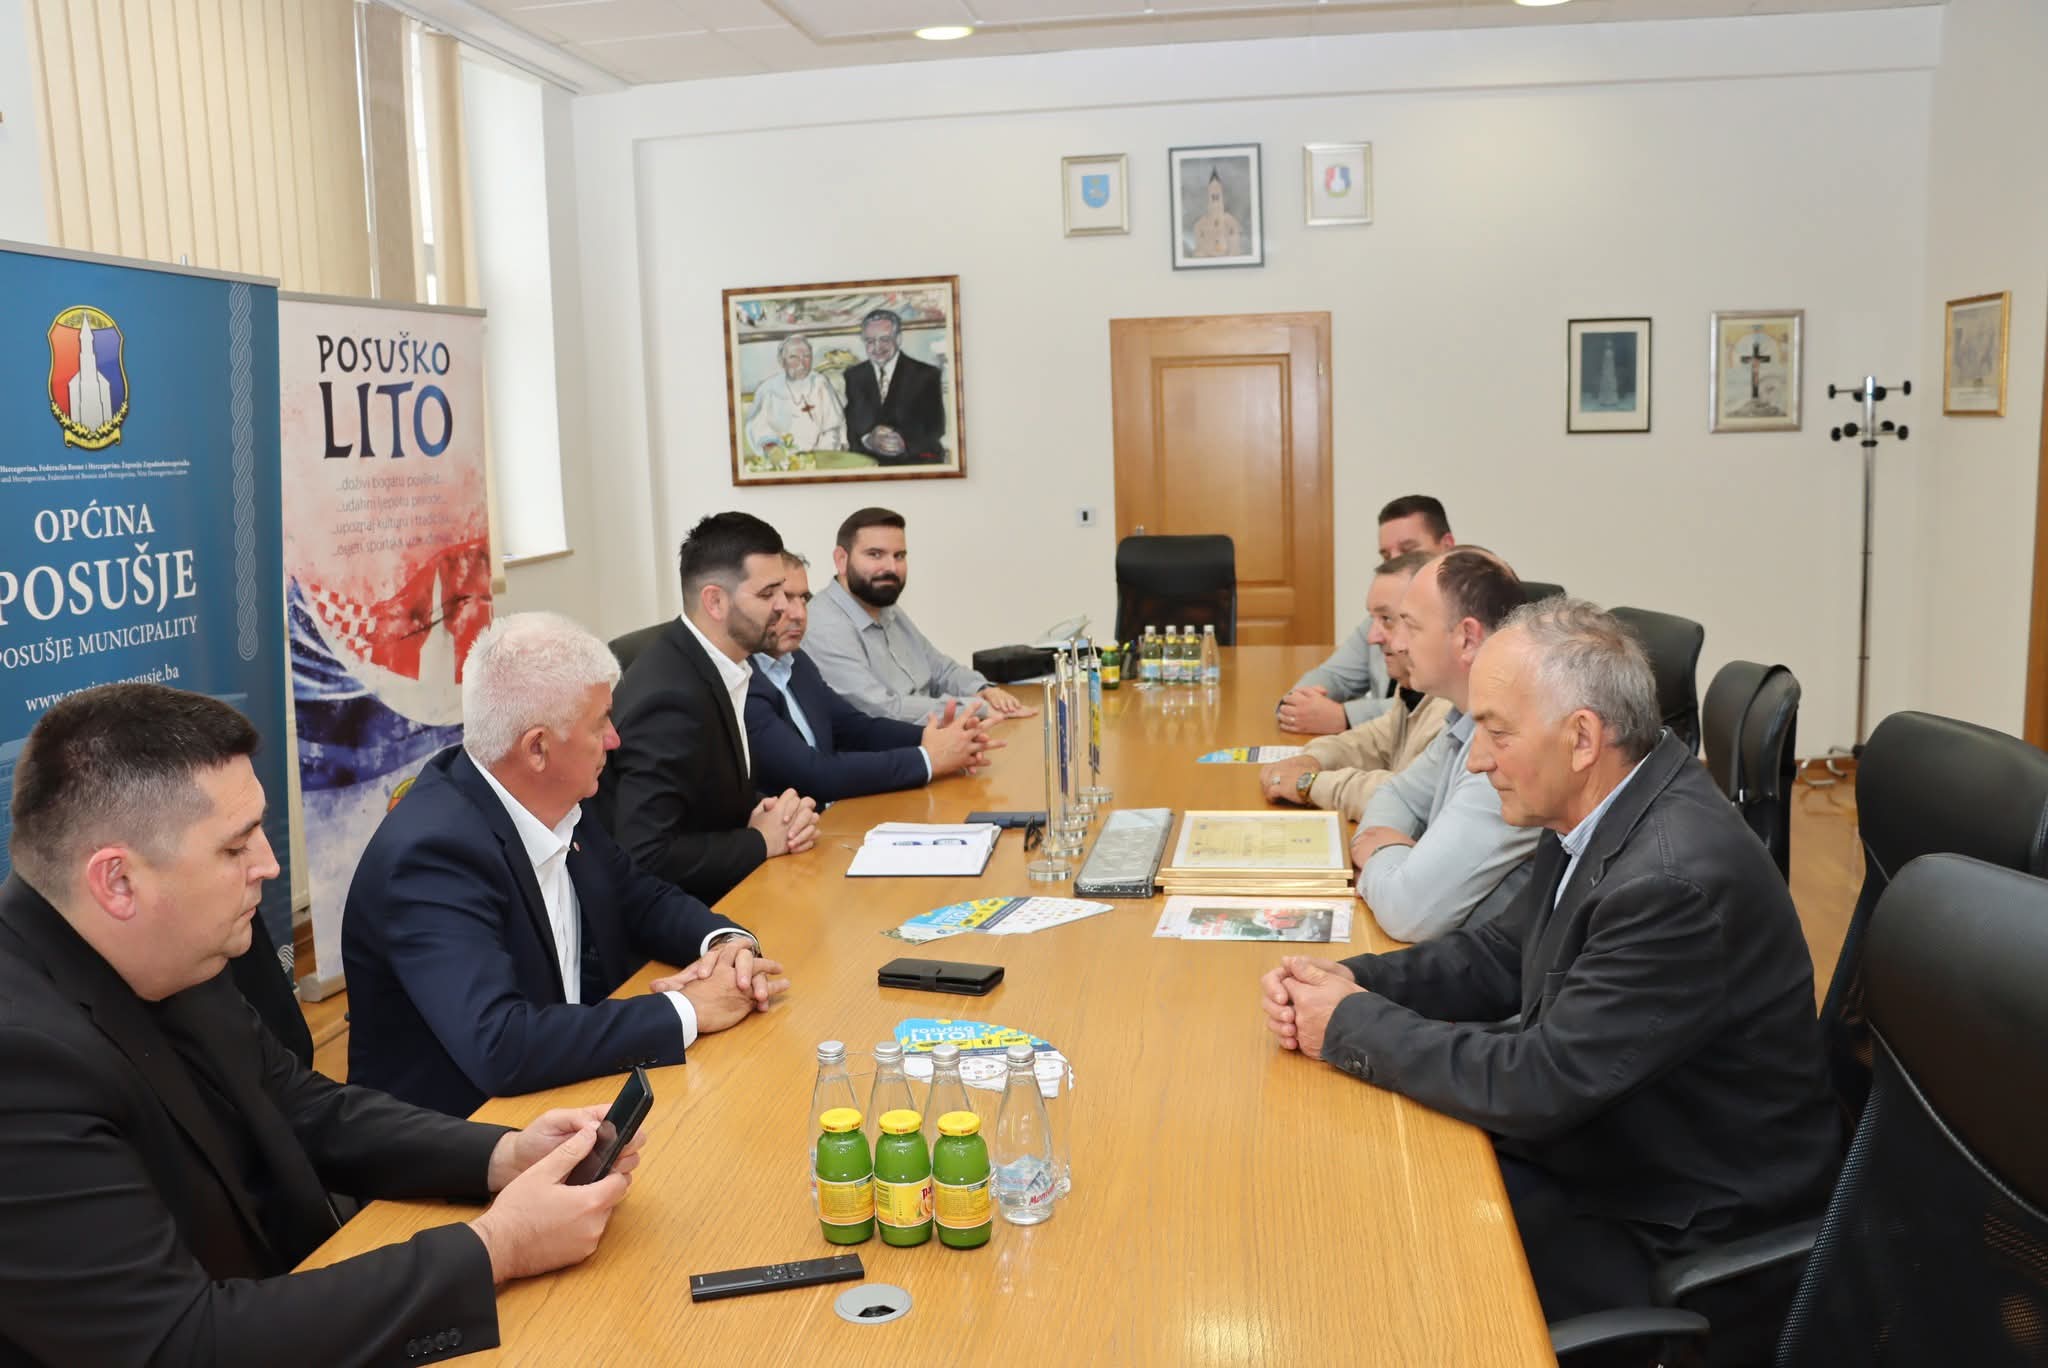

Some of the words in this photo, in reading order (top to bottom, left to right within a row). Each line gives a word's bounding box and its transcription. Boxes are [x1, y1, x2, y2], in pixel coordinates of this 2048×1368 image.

[316, 331, 450, 375] POSUŠKO
[318, 381, 453, 459] LITO
[34, 499, 155, 543] OPĆINA
[0, 541, 197, 626] POSUŠJE
[0, 637, 73, 669] OSUŠJE
[78, 615, 198, 656] MUNICIPALITY
[911, 1031, 966, 1042] LITO
